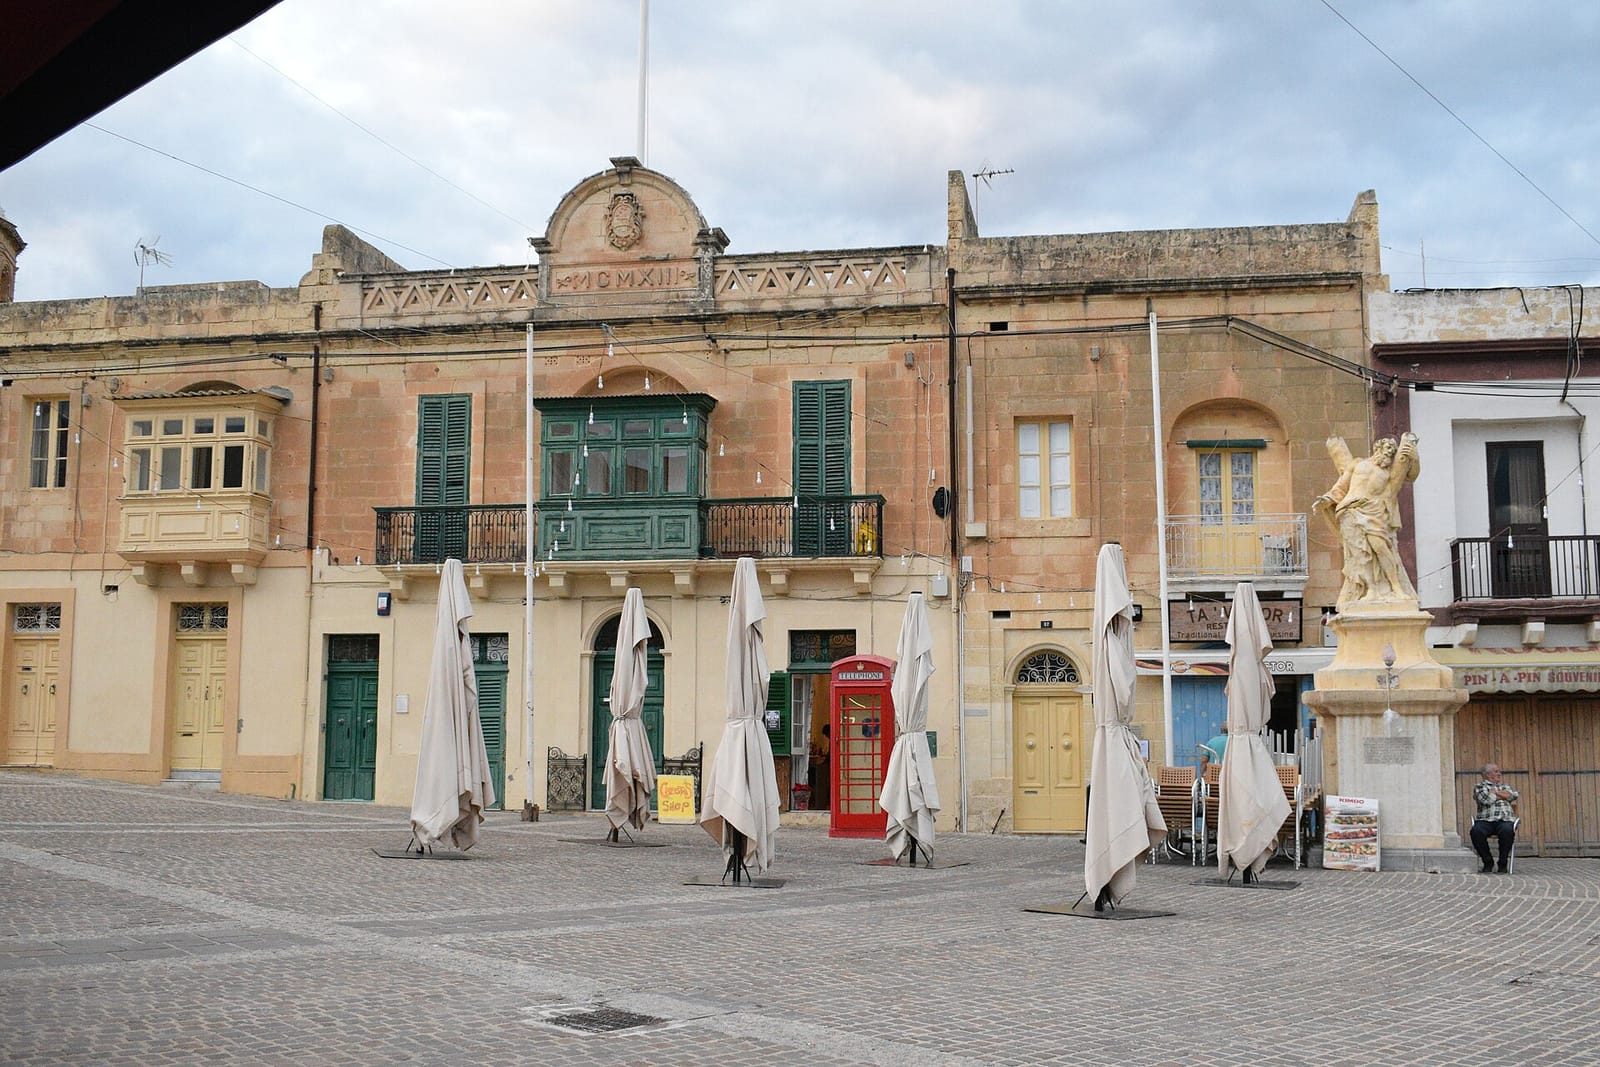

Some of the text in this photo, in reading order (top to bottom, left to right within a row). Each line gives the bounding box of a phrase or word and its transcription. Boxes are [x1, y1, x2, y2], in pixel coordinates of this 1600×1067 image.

[572, 267, 679, 289] MCMXIII
[1463, 674, 1488, 685] PIN
[1548, 671, 1600, 683] SOUVENI
